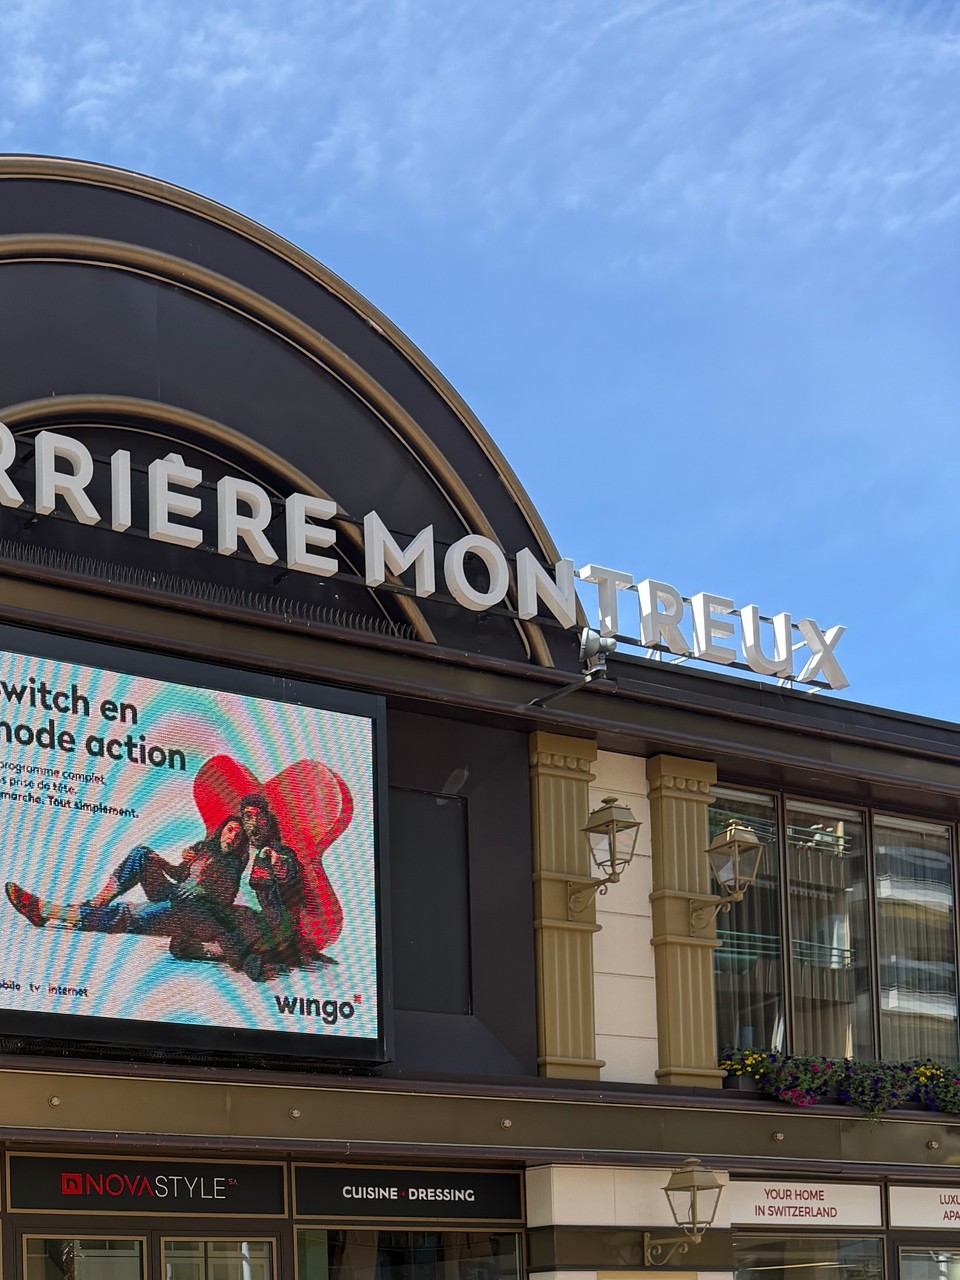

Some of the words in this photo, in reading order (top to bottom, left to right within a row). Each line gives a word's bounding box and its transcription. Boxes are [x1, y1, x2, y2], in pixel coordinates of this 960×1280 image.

[364, 510, 850, 690] MONTREUX
[100, 699, 138, 725] en
[85, 734, 186, 771] action
[37, 779, 51, 790] de
[47, 796, 72, 808] Tout
[29, 983, 40, 992] tv
[48, 983, 89, 997] internet
[274, 995, 355, 1025] wingo
[85, 1173, 226, 1199] NOVASTYLE
[342, 1186, 398, 1199] CUISINE
[408, 1188, 475, 1201] DRESSING
[764, 1188, 792, 1200] YOUR
[794, 1189, 825, 1201] HOME
[754, 1205, 765, 1217] IN
[768, 1205, 838, 1218] SWITZERLAND
